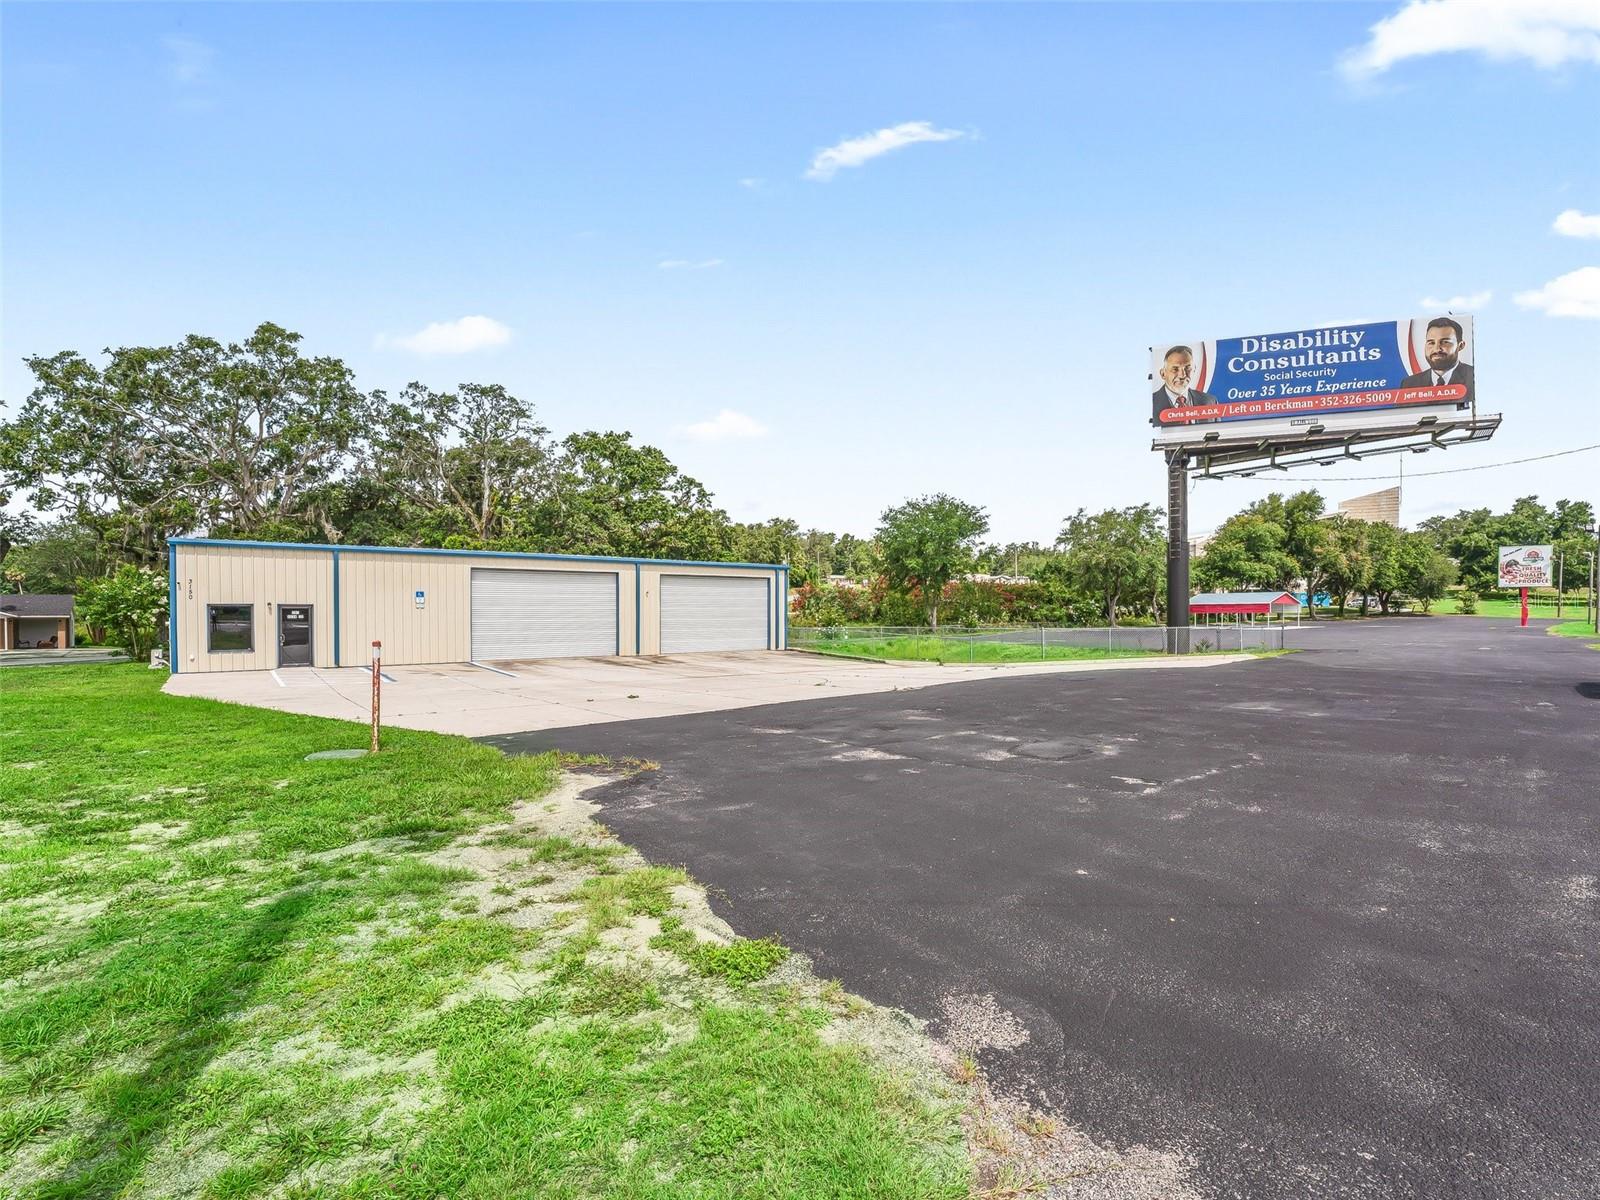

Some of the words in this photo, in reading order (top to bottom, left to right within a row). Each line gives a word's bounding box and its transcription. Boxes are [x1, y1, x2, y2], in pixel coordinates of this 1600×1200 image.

[1241, 329, 1365, 355] Disability
[1228, 346, 1382, 373] Consultants
[1264, 370, 1293, 382] Social
[1296, 367, 1337, 379] Security
[1228, 388, 1257, 400] Over
[1260, 385, 1276, 397] 35
[1280, 383, 1312, 395] Years
[1316, 378, 1387, 392] Experience
[1167, 411, 1184, 419] Chris
[1229, 404, 1247, 414] Left
[1250, 404, 1262, 413] on
[1264, 400, 1313, 412] Berckman
[1320, 392, 1392, 407] 352-326-5009
[1404, 392, 1417, 401] Jeff
[1437, 388, 1459, 396] A.D.R.
